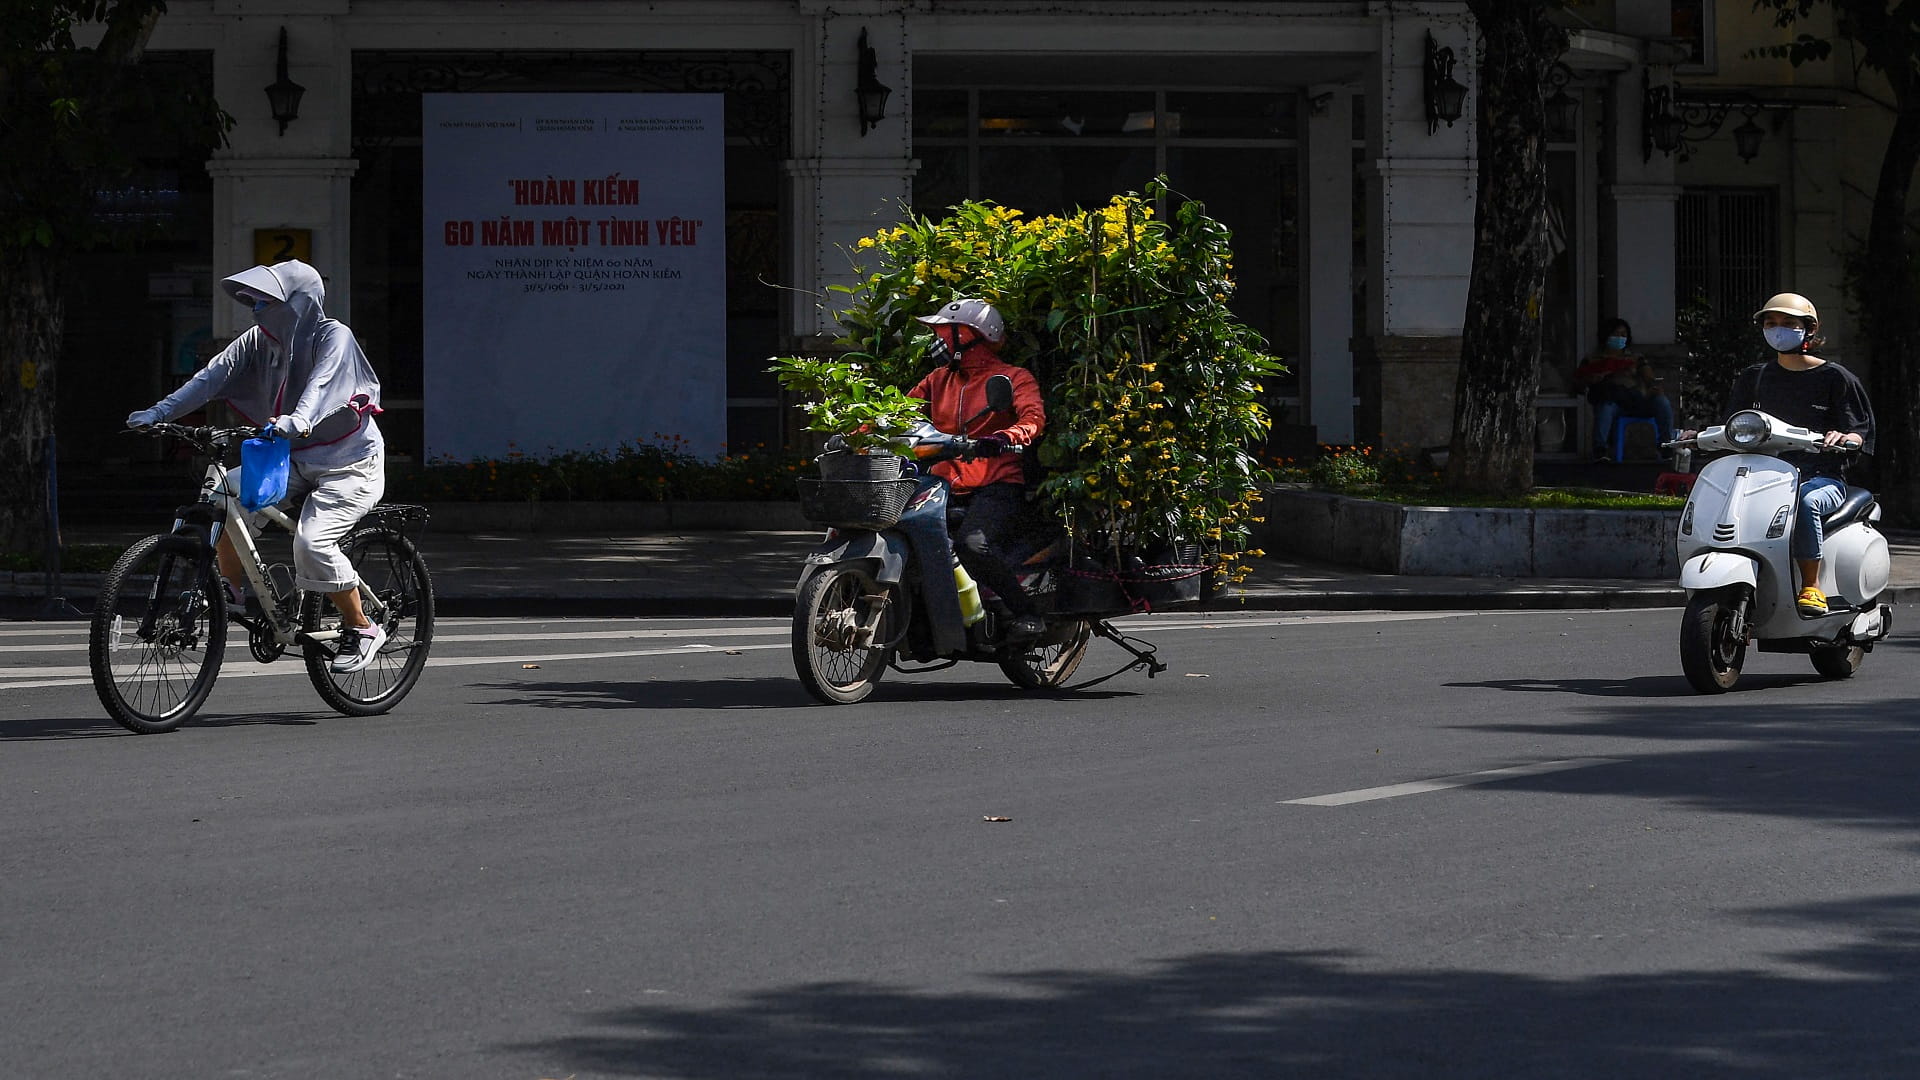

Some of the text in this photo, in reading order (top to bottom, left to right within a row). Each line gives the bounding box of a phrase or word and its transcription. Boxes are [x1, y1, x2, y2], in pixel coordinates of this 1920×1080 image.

[583, 172, 639, 206] KIẾM
[445, 221, 474, 246] 60
[481, 216, 535, 246] NĂM
[542, 216, 591, 252] MỘT
[597, 216, 649, 246] TÌNH
[273, 235, 295, 260] 2
[504, 269, 546, 280] THÀNH
[549, 269, 571, 281] LẠP
[574, 269, 610, 281] QUẬN
[613, 269, 650, 280] HOÀN
[606, 258, 621, 268] 60
